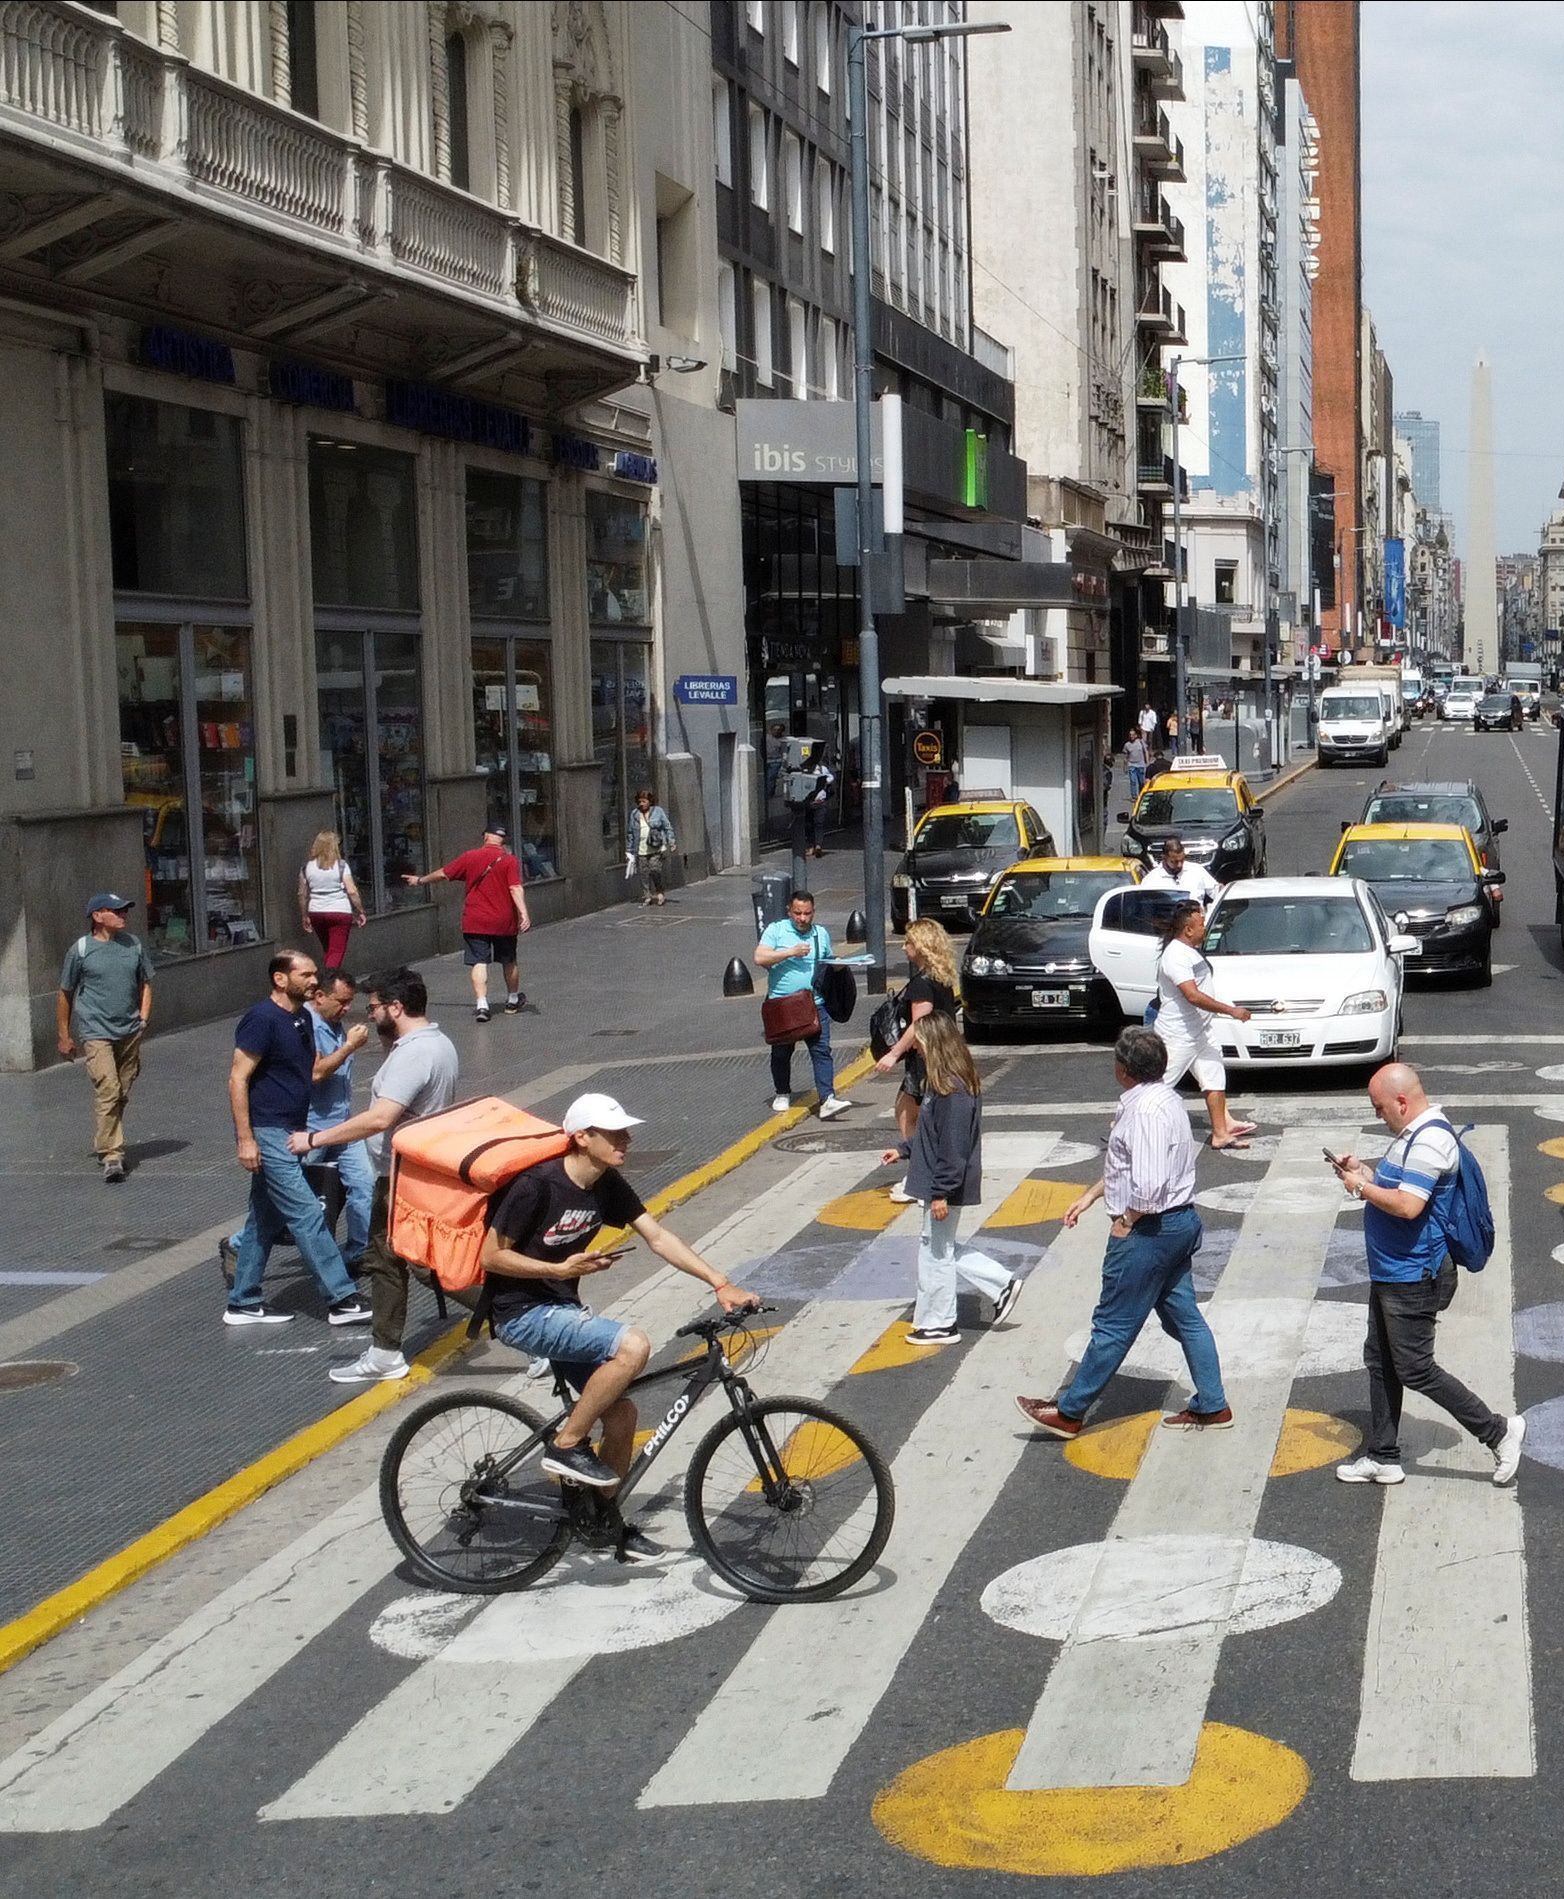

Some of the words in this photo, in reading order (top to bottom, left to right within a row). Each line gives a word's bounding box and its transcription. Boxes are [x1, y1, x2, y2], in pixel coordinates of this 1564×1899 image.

[754, 443, 806, 472] ibis
[814, 456, 884, 473] STYLS
[684, 681, 731, 691] LIBRERIAS
[688, 690, 727, 699] LEVALLE
[644, 1398, 687, 1456] PHILCO
